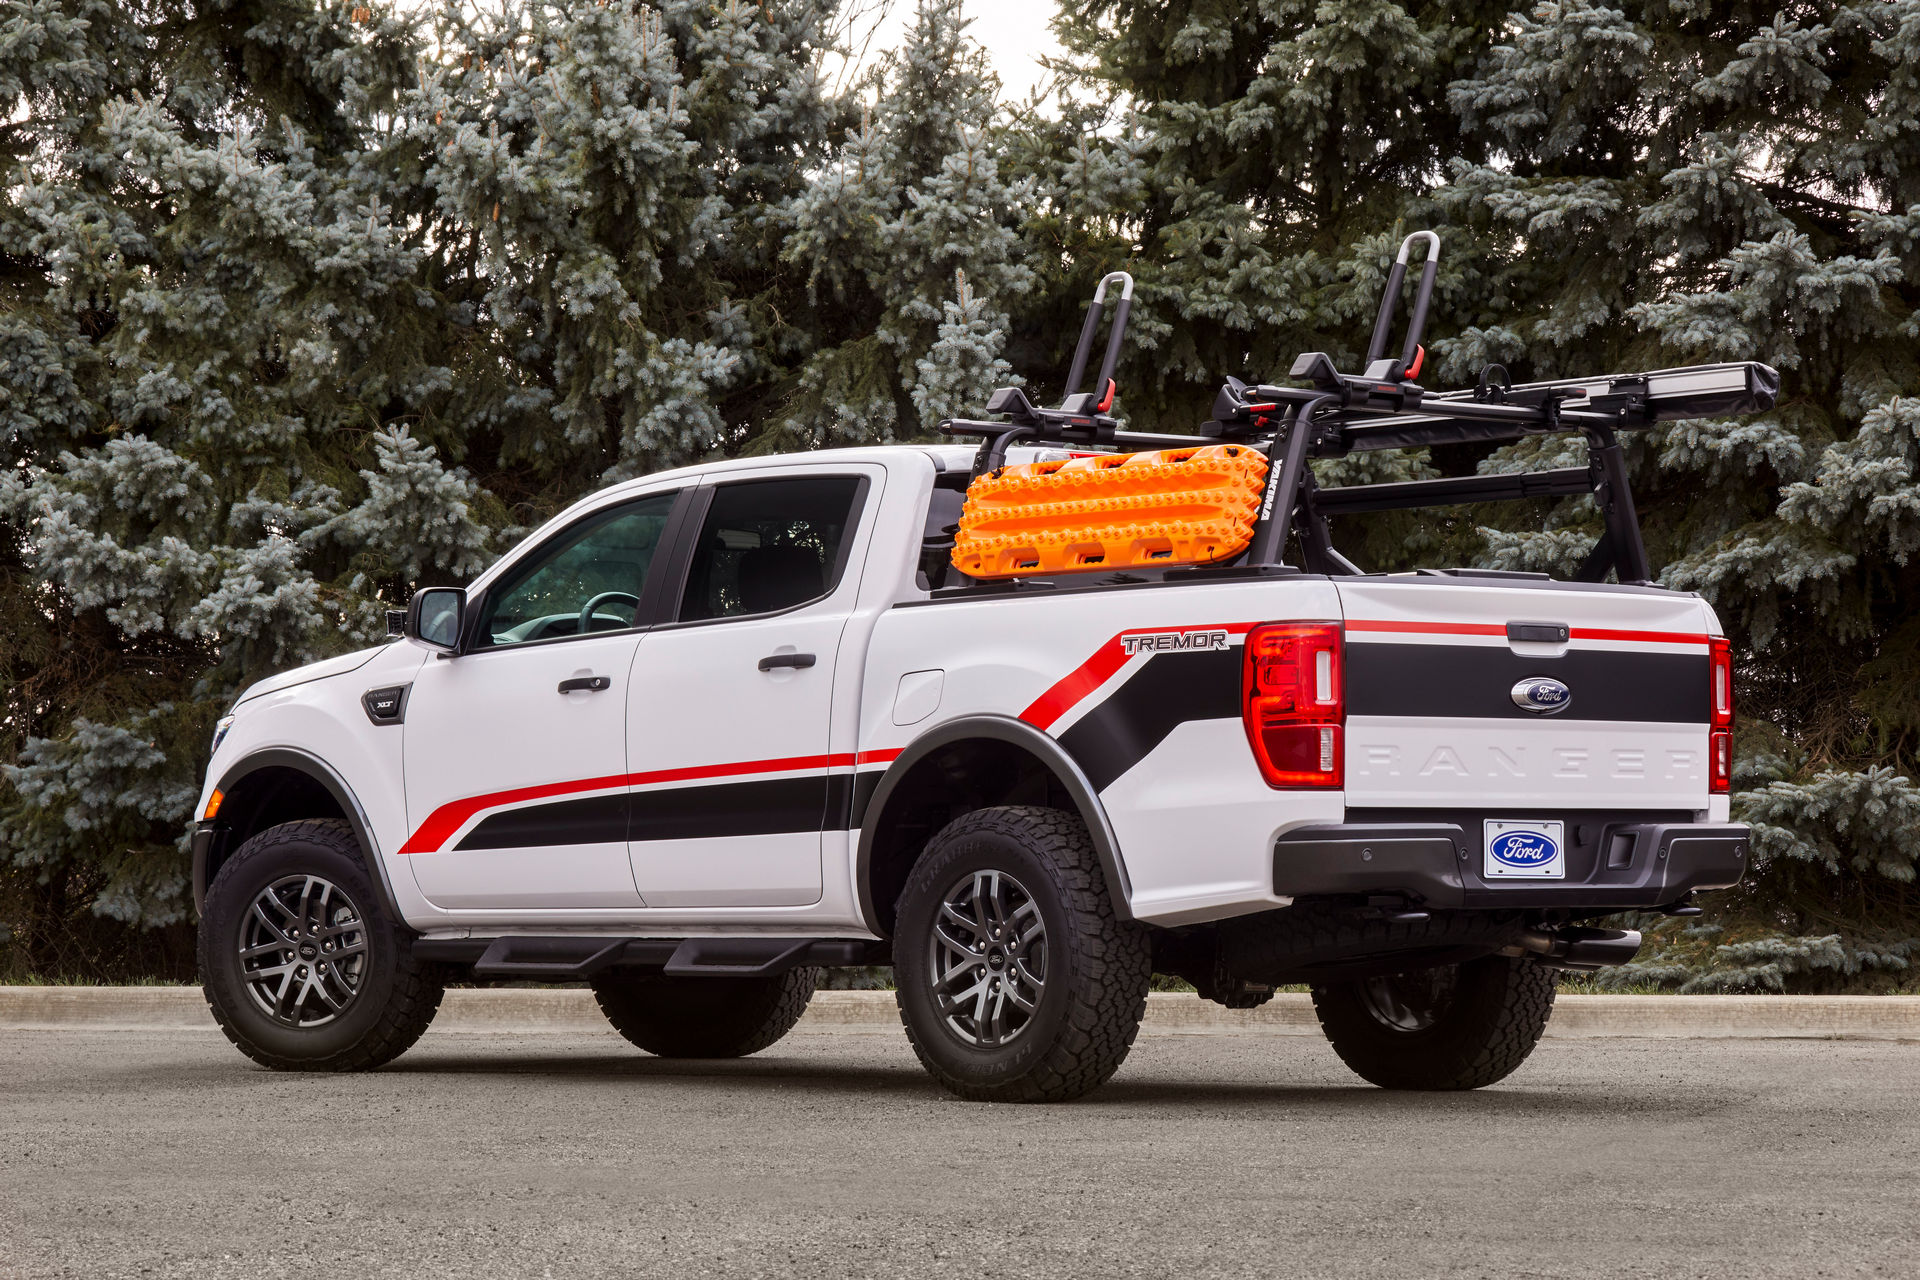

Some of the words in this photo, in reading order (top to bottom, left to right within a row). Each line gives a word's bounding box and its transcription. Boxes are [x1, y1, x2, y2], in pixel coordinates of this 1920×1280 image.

[1261, 459, 1283, 521] YAKIMA
[1122, 631, 1229, 654] TREMOR
[377, 700, 394, 709] XLT
[1537, 685, 1562, 701] Ford
[1359, 745, 1699, 781] RANGER
[1503, 837, 1545, 860] Ford
